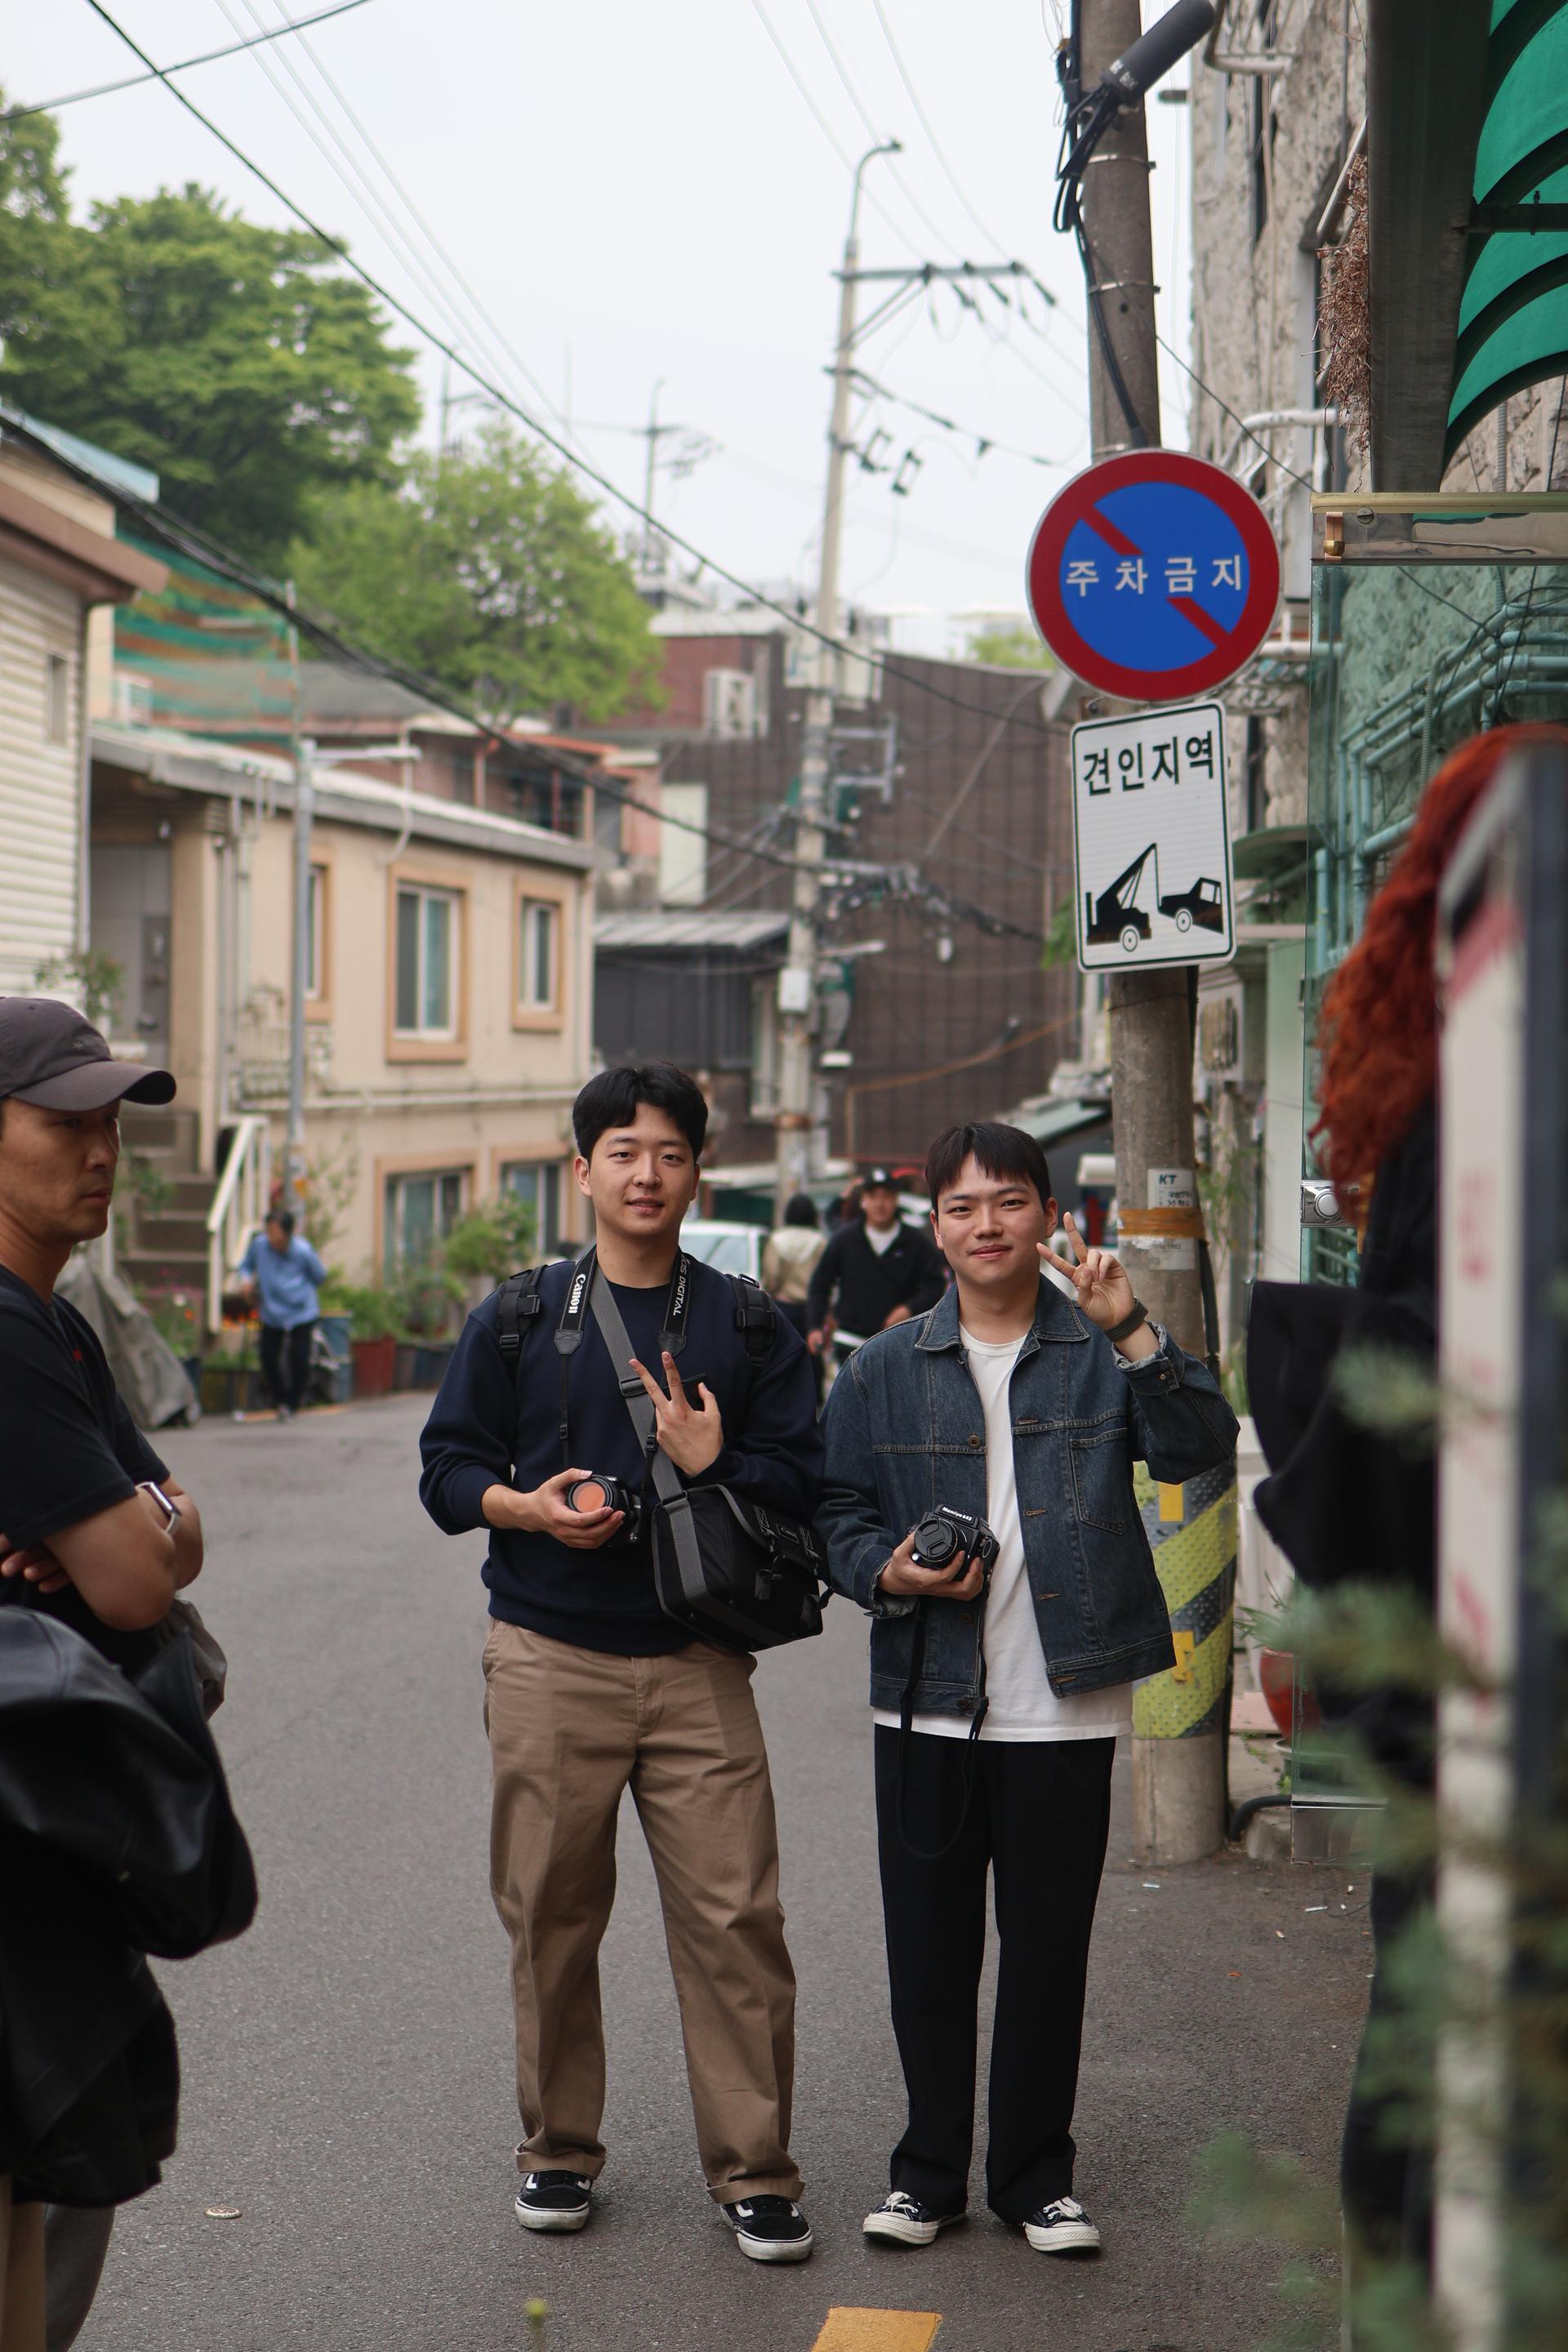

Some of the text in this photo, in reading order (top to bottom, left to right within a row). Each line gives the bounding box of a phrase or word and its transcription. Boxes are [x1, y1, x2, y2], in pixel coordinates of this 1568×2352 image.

[1083, 730, 1214, 796] 견인지역
[1159, 1174, 1177, 1185] KT
[568, 1273, 586, 1314] Canon
[673, 1276, 687, 1316] DIGITAL
[942, 1506, 963, 1518] Mamiya
